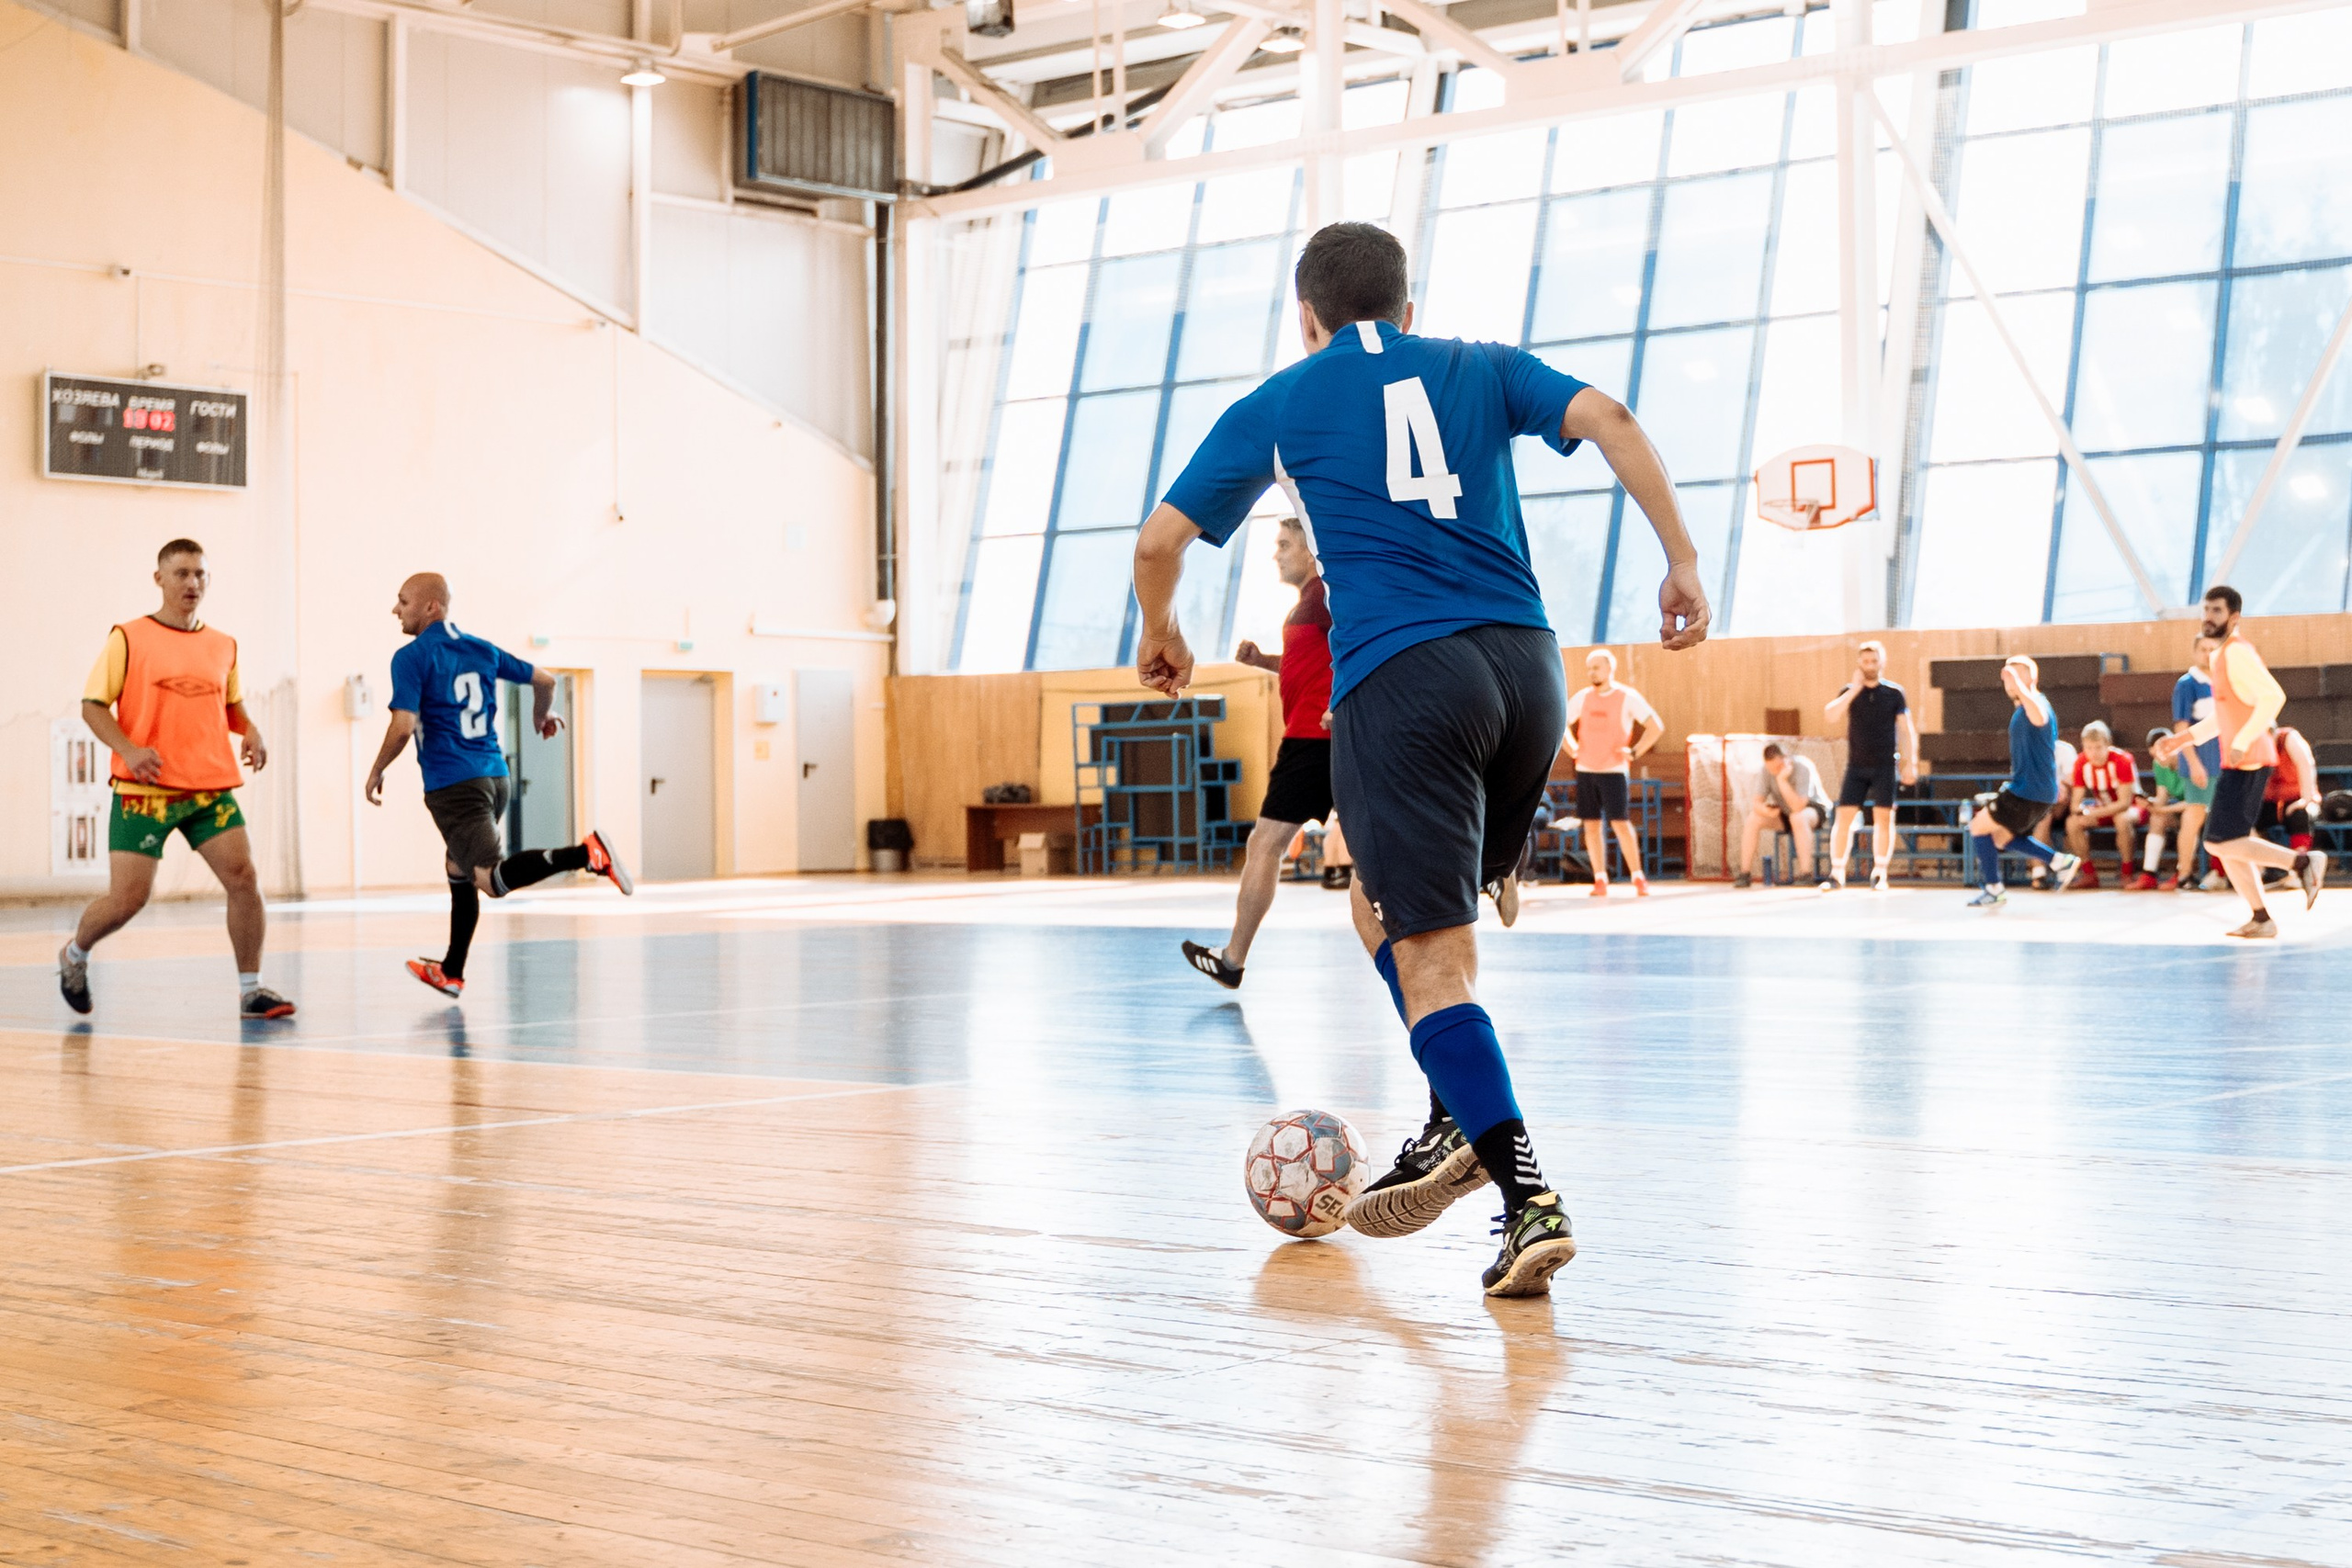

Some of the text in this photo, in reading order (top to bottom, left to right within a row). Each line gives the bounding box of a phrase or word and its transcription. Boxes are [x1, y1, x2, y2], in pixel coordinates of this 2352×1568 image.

[52, 388, 120, 407] ХОЗЯЕВА
[129, 396, 175, 411] ВРЕМЯ
[190, 400, 237, 418] ГОСТИ
[130, 435, 175, 452] ПЕРИОД
[1384, 376, 1463, 519] 4
[454, 671, 488, 739] 2
[1315, 1193, 1347, 1222] SEL
